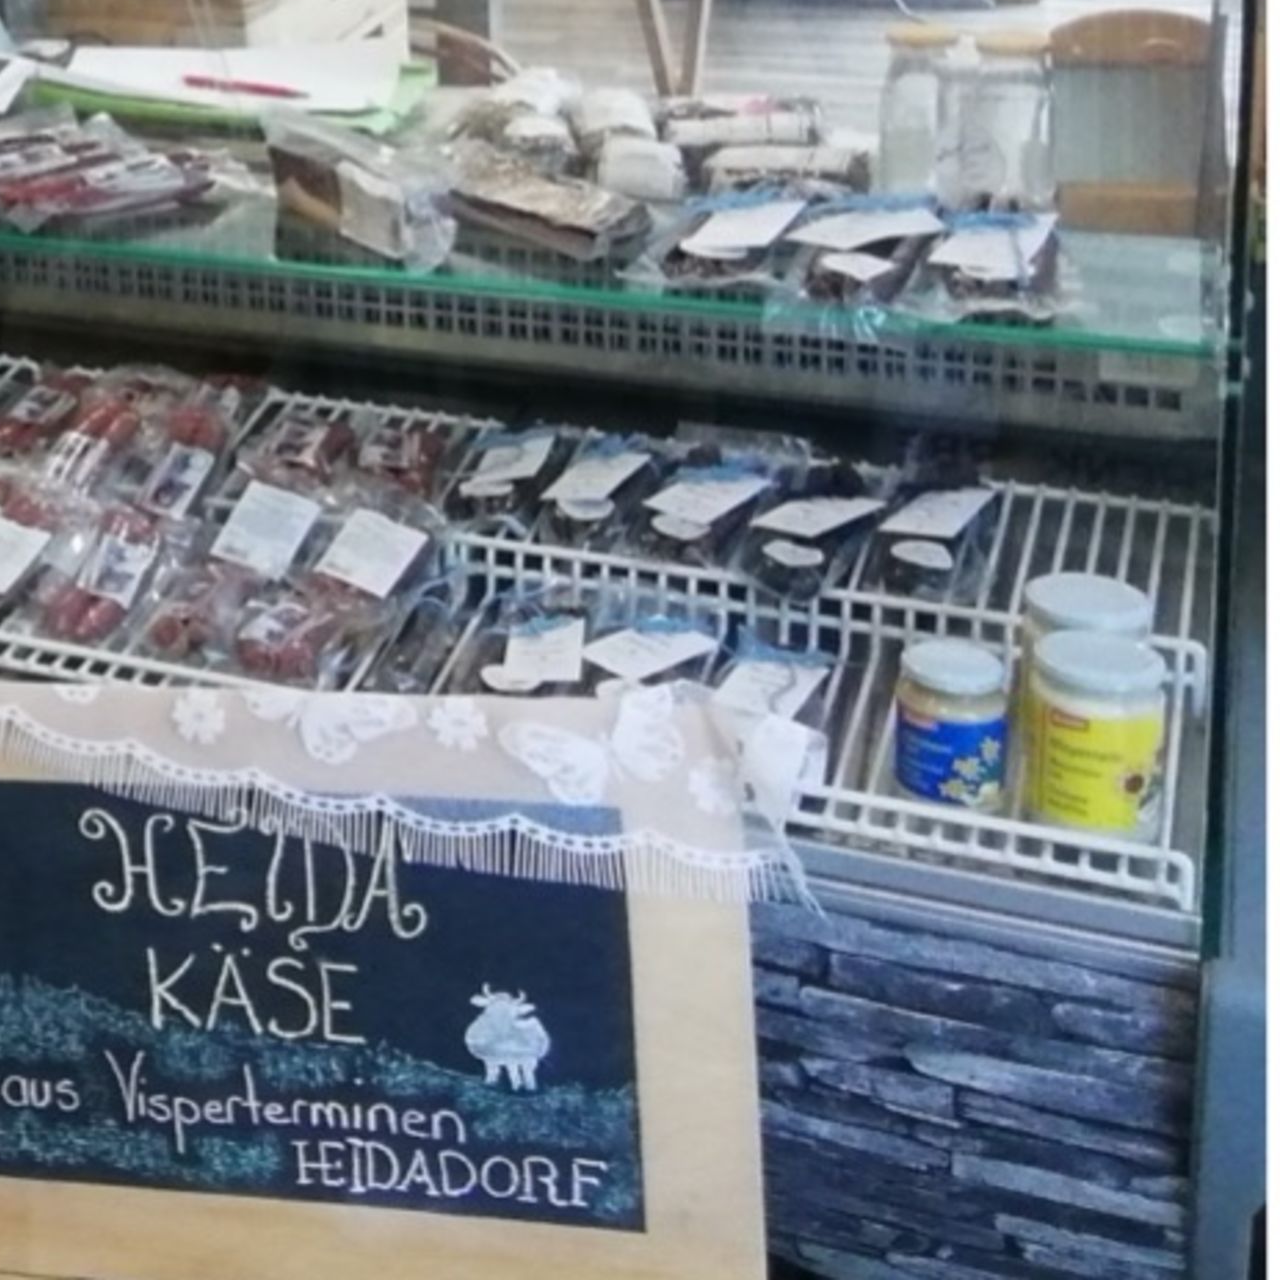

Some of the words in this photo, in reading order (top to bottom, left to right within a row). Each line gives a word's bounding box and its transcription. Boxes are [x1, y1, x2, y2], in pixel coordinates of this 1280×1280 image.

[78, 806, 428, 951] HEIDA
[144, 941, 367, 1043] KÄSE
[0, 1071, 81, 1113] aus
[103, 1048, 468, 1155] Visperterminen
[292, 1134, 610, 1208] HEIDADORF
